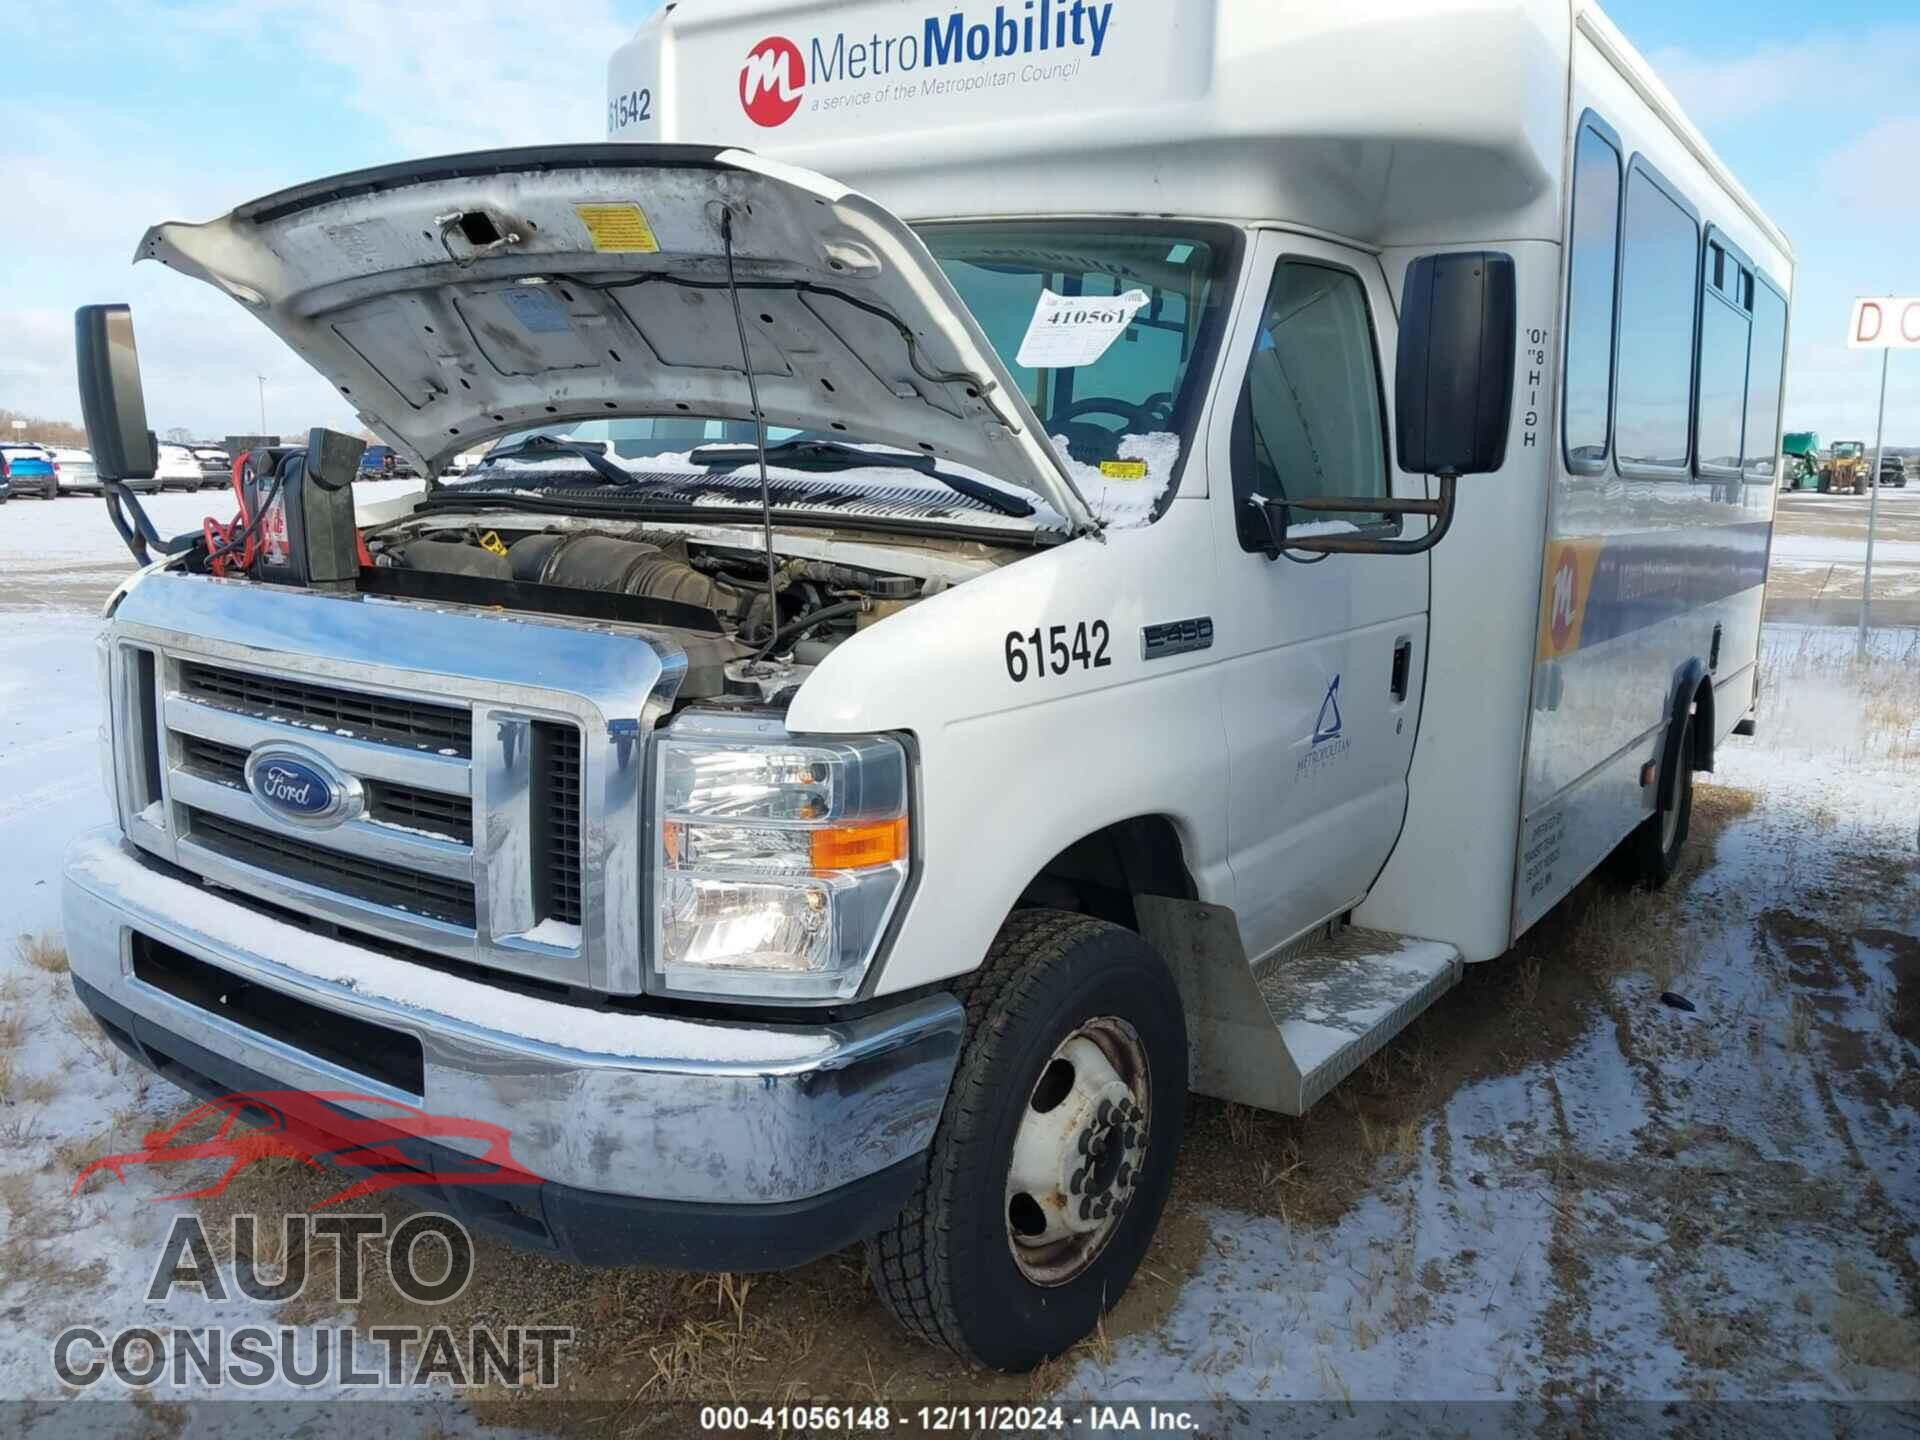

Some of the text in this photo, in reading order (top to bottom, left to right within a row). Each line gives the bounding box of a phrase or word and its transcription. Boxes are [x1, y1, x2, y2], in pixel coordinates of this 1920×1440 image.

[811, 0, 1113, 85] MetroMobility
[823, 90, 870, 110] service
[875, 85, 891, 101] of
[894, 84, 916, 100] the
[920, 69, 1016, 97] Metropolitan
[1021, 58, 1081, 83] Council
[1005, 619, 1111, 683] 61542
[263, 766, 311, 806] Ford
